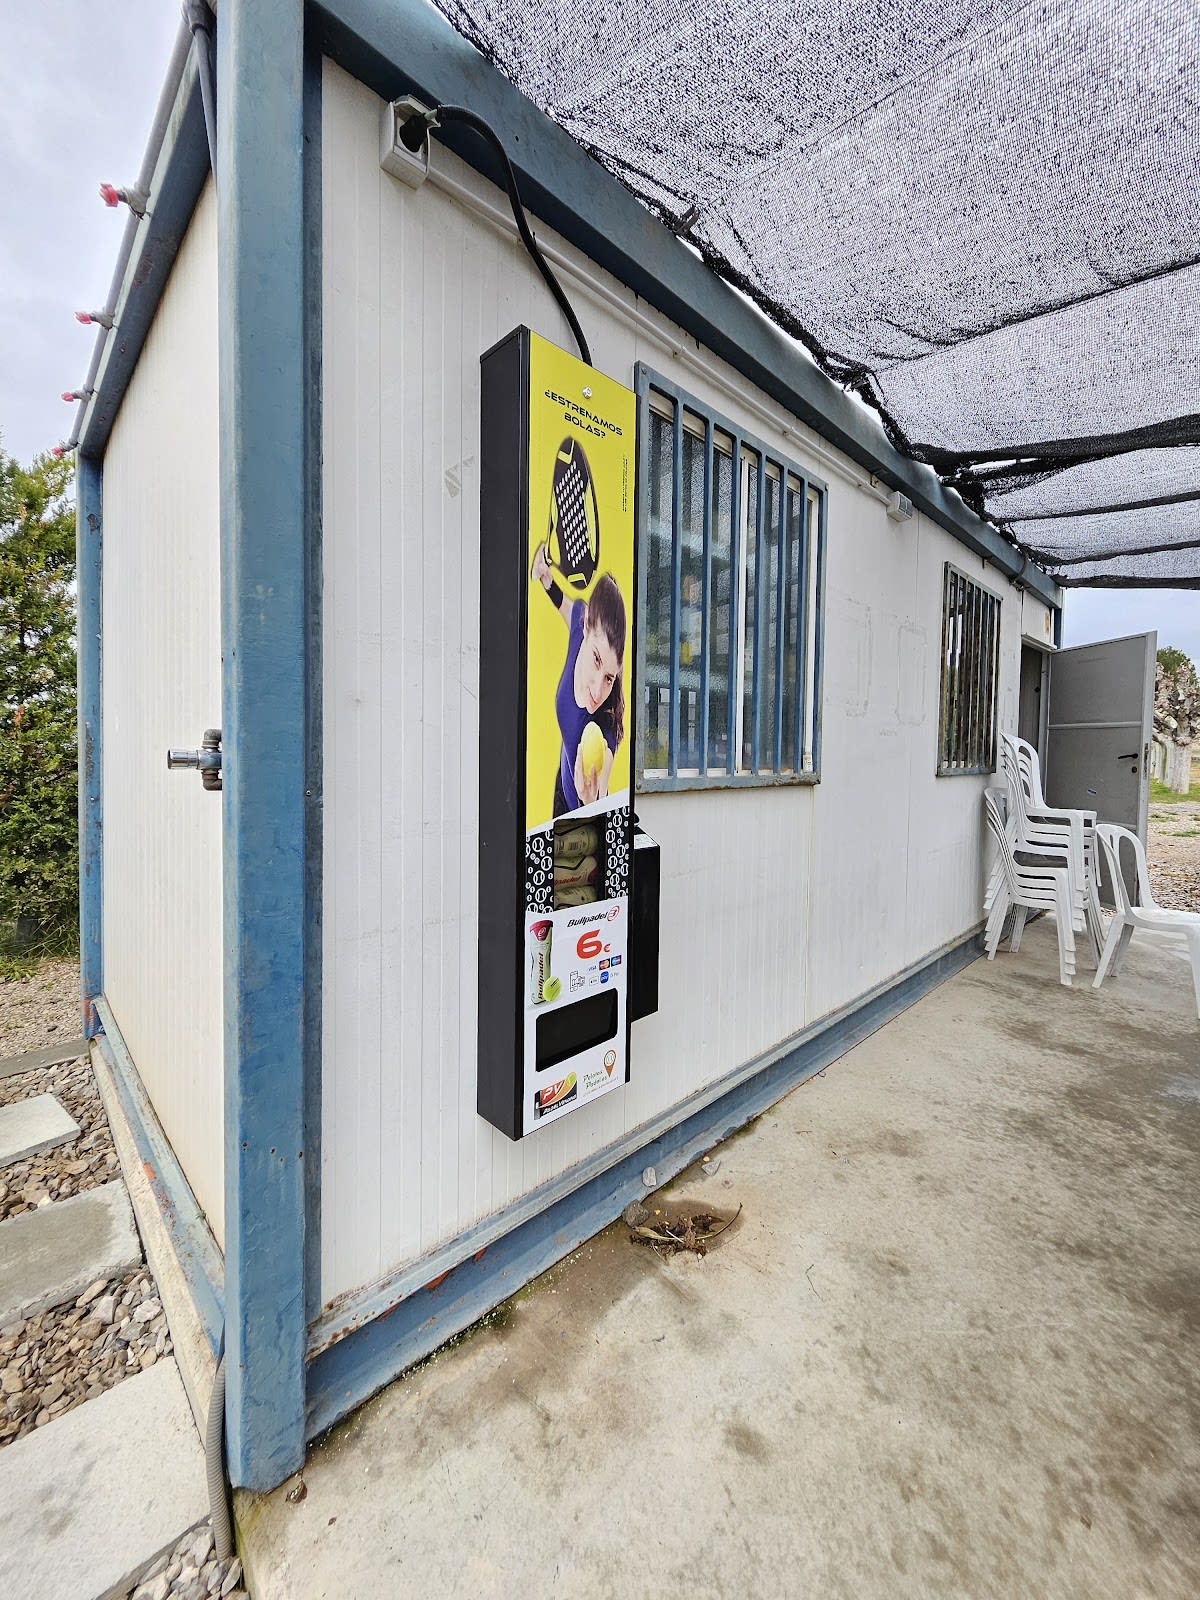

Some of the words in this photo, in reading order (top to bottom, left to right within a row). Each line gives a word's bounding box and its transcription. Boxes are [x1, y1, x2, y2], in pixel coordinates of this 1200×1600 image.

[544, 390, 623, 436] ¿ESTRENAMOS
[564, 412, 606, 438] BOLAS?
[567, 912, 608, 927] Bullpadel
